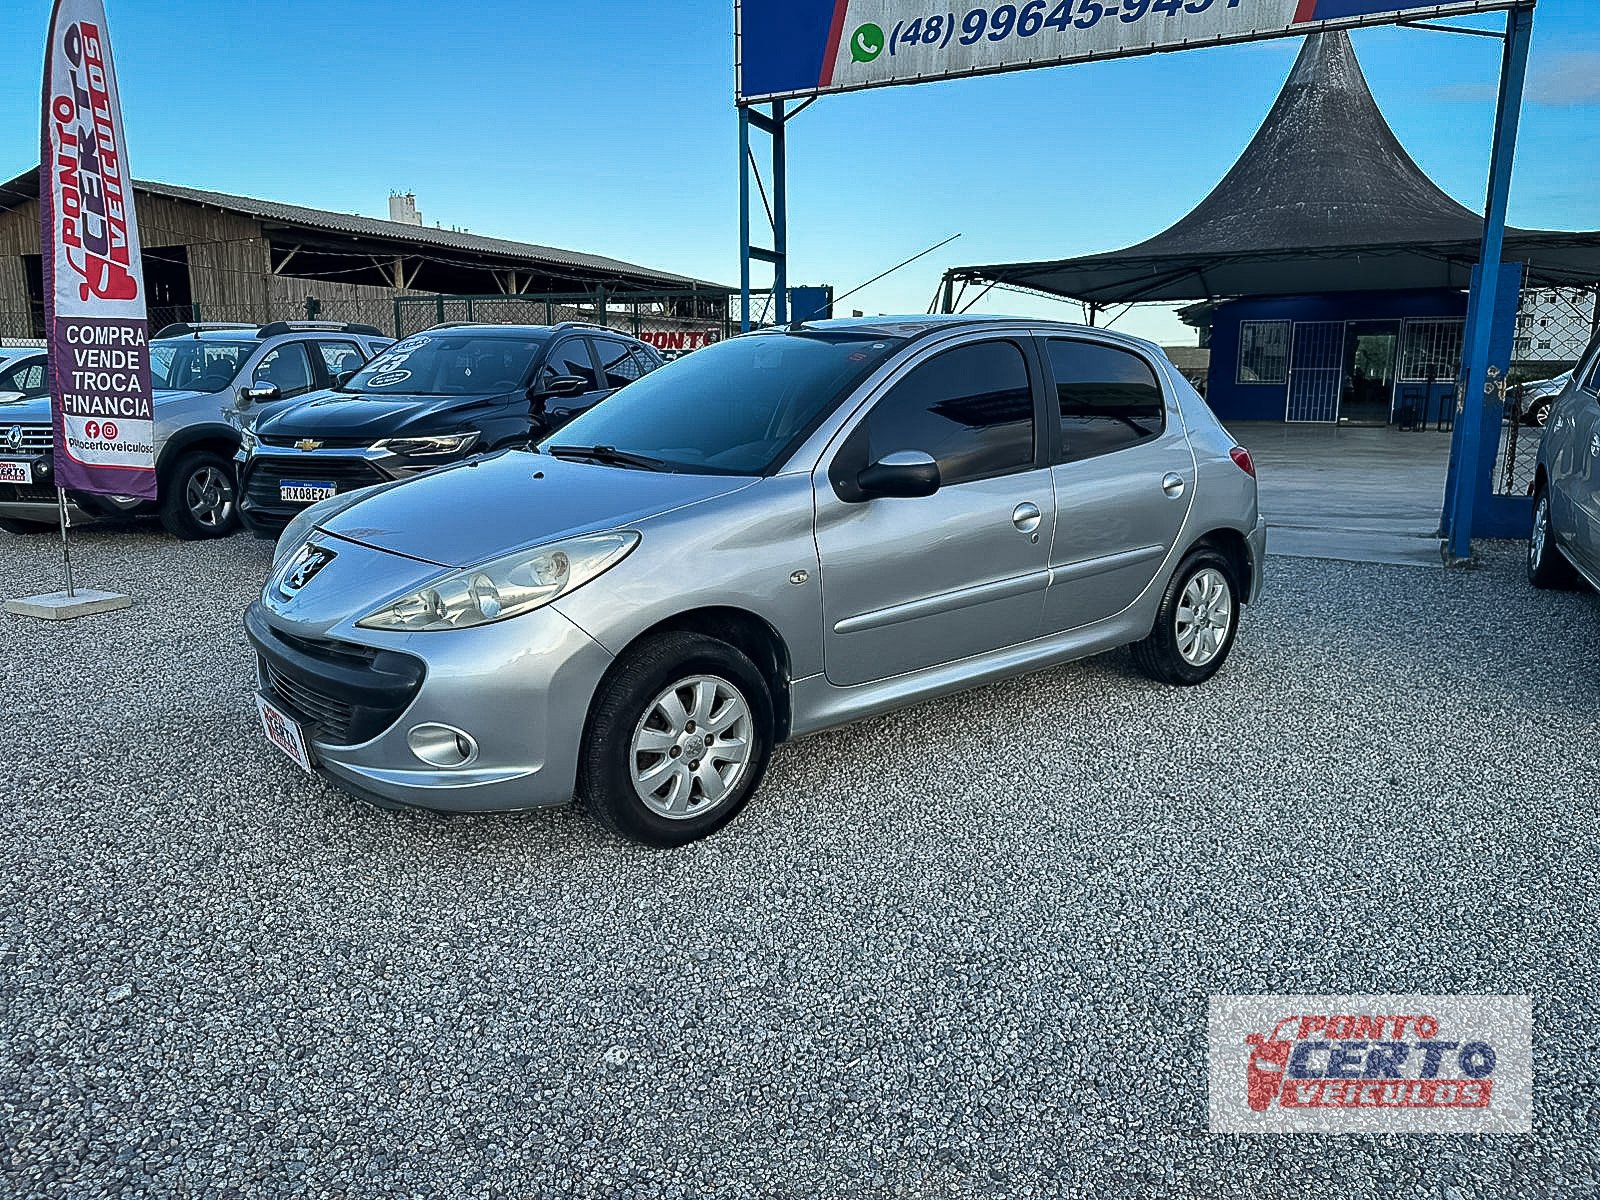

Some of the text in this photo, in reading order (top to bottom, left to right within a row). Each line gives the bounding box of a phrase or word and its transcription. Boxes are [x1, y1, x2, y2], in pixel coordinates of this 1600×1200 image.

[889, 13, 955, 56] (48)
[64, 22, 108, 256] CERTO
[83, 35, 127, 248] VEICULOS
[53, 95, 82, 248] PONTO
[66, 325, 146, 347] COMPRA
[74, 348, 140, 370] VENDE
[71, 371, 142, 393] TROCA
[63, 393, 151, 417] FINANCIA
